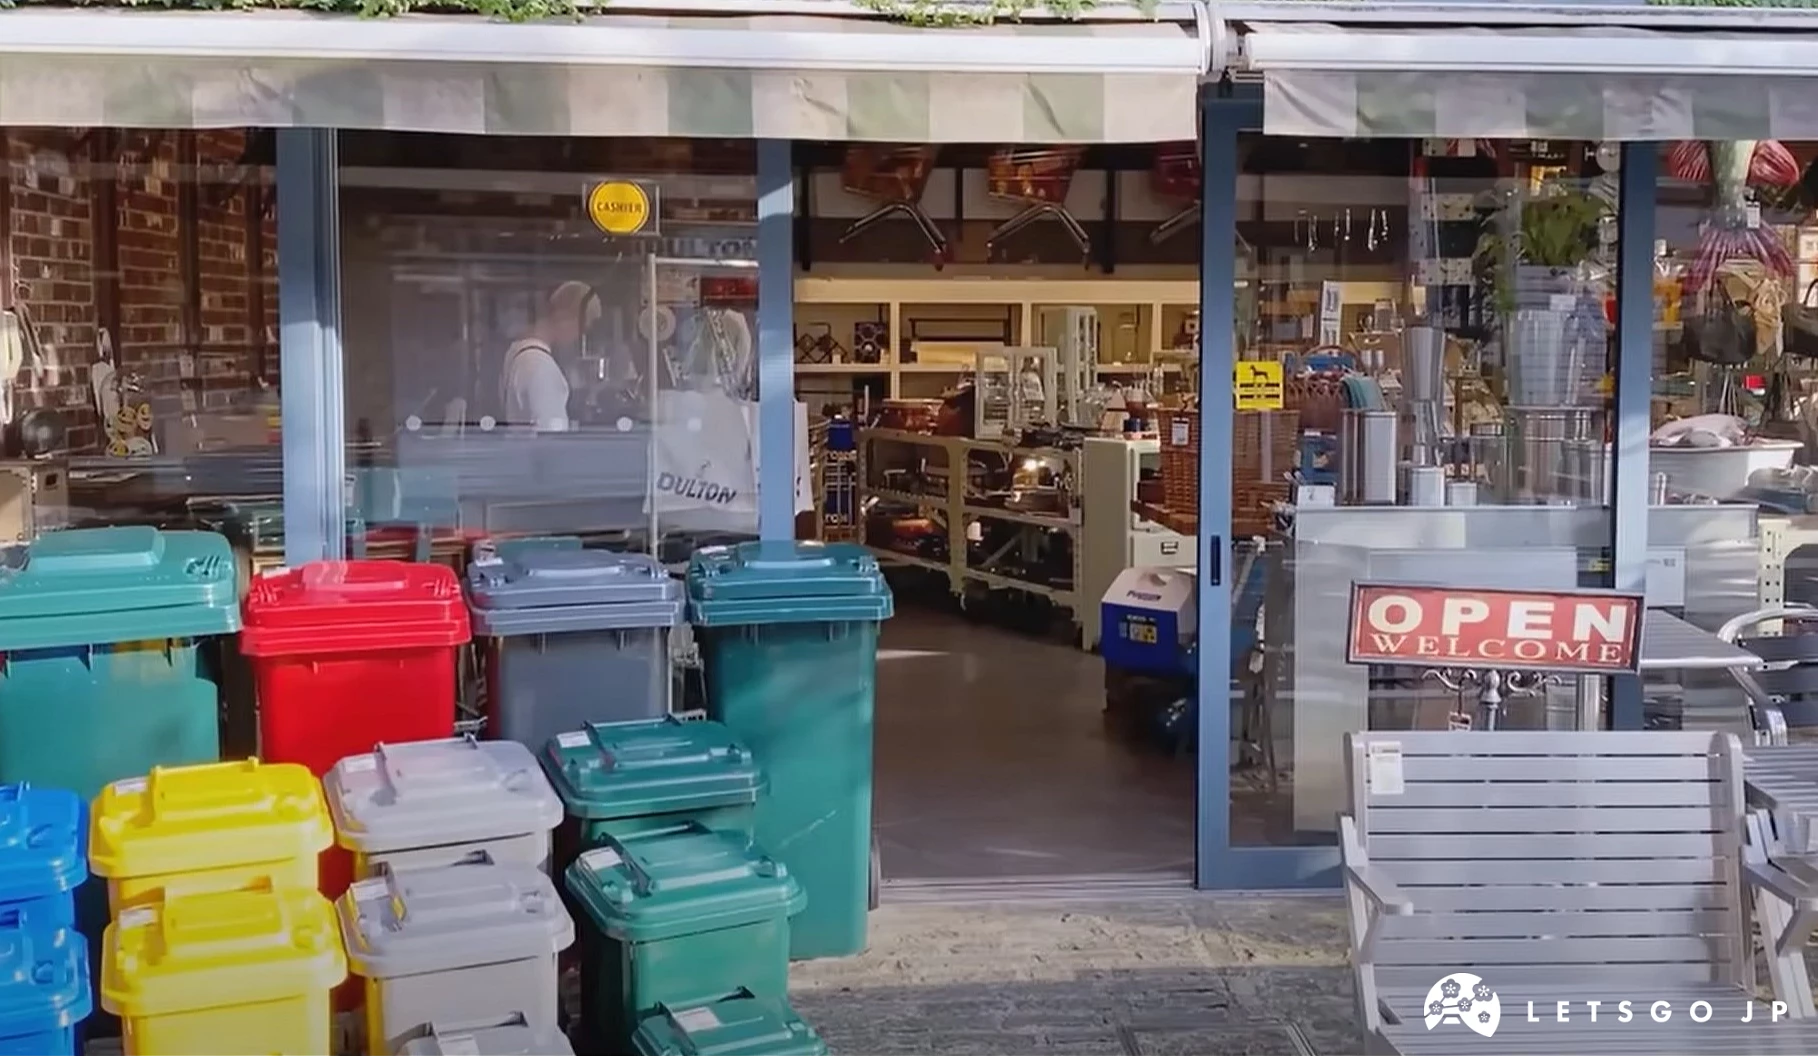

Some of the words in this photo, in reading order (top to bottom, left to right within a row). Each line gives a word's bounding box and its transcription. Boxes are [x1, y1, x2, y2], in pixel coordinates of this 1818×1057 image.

[597, 202, 643, 214] CASHIER
[657, 471, 737, 504] DULTON
[1368, 595, 1628, 643] OPEN
[1370, 633, 1623, 663] WELCOME
